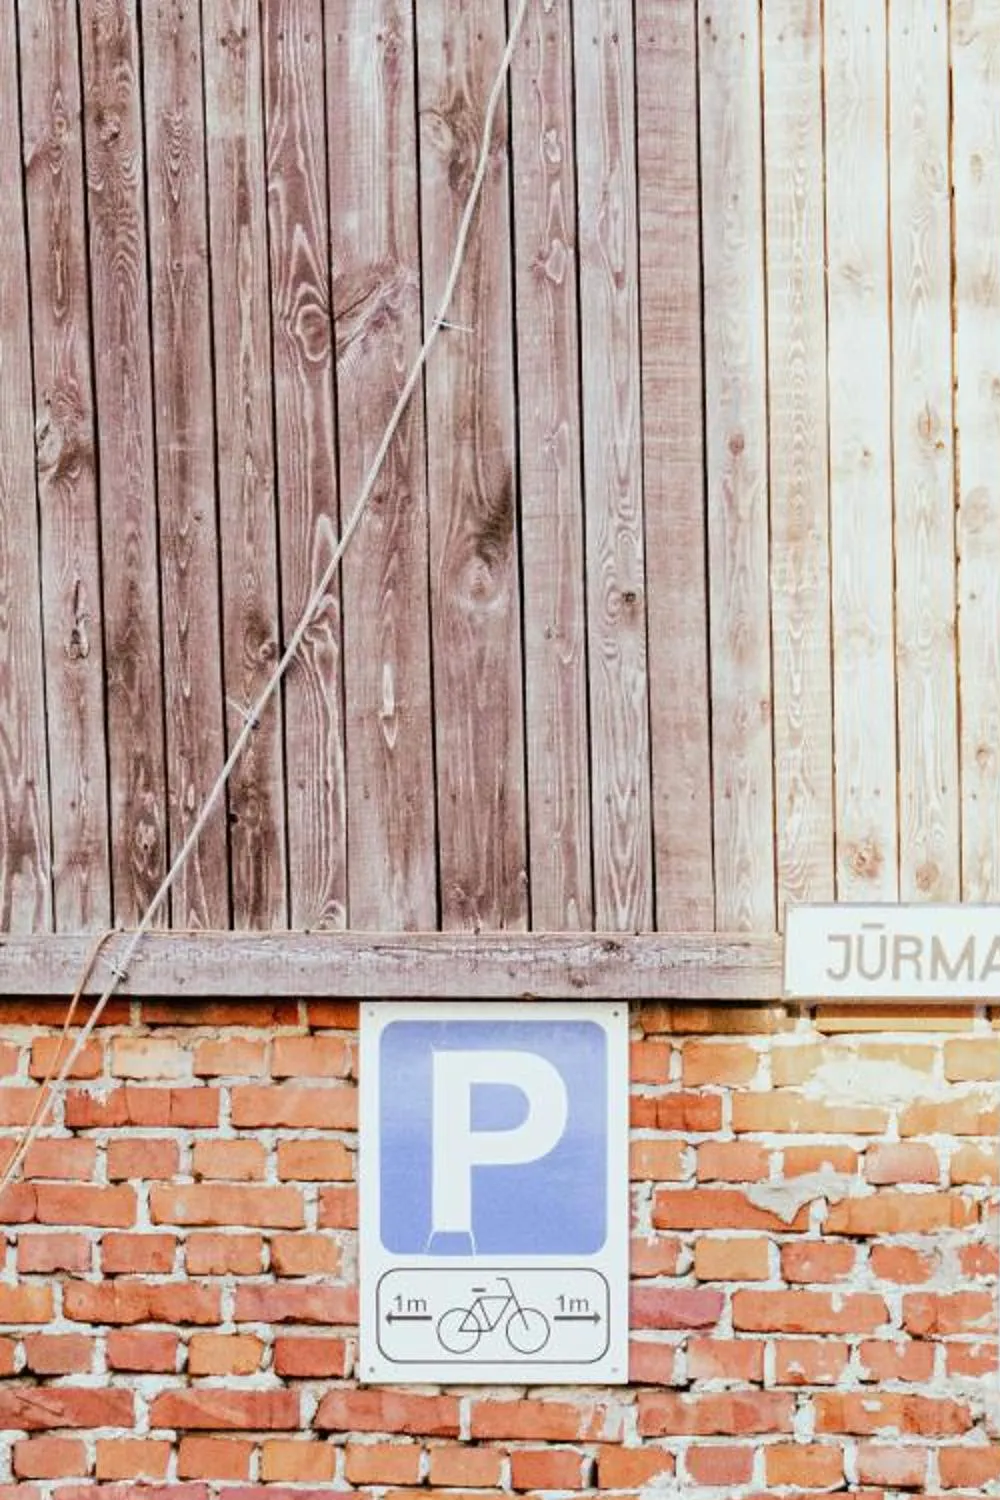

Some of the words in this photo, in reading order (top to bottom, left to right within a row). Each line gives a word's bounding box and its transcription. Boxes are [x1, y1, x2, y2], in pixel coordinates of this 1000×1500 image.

[432, 1050, 568, 1233] P
[393, 1294, 427, 1313] 1m
[556, 1294, 590, 1313] 1m
